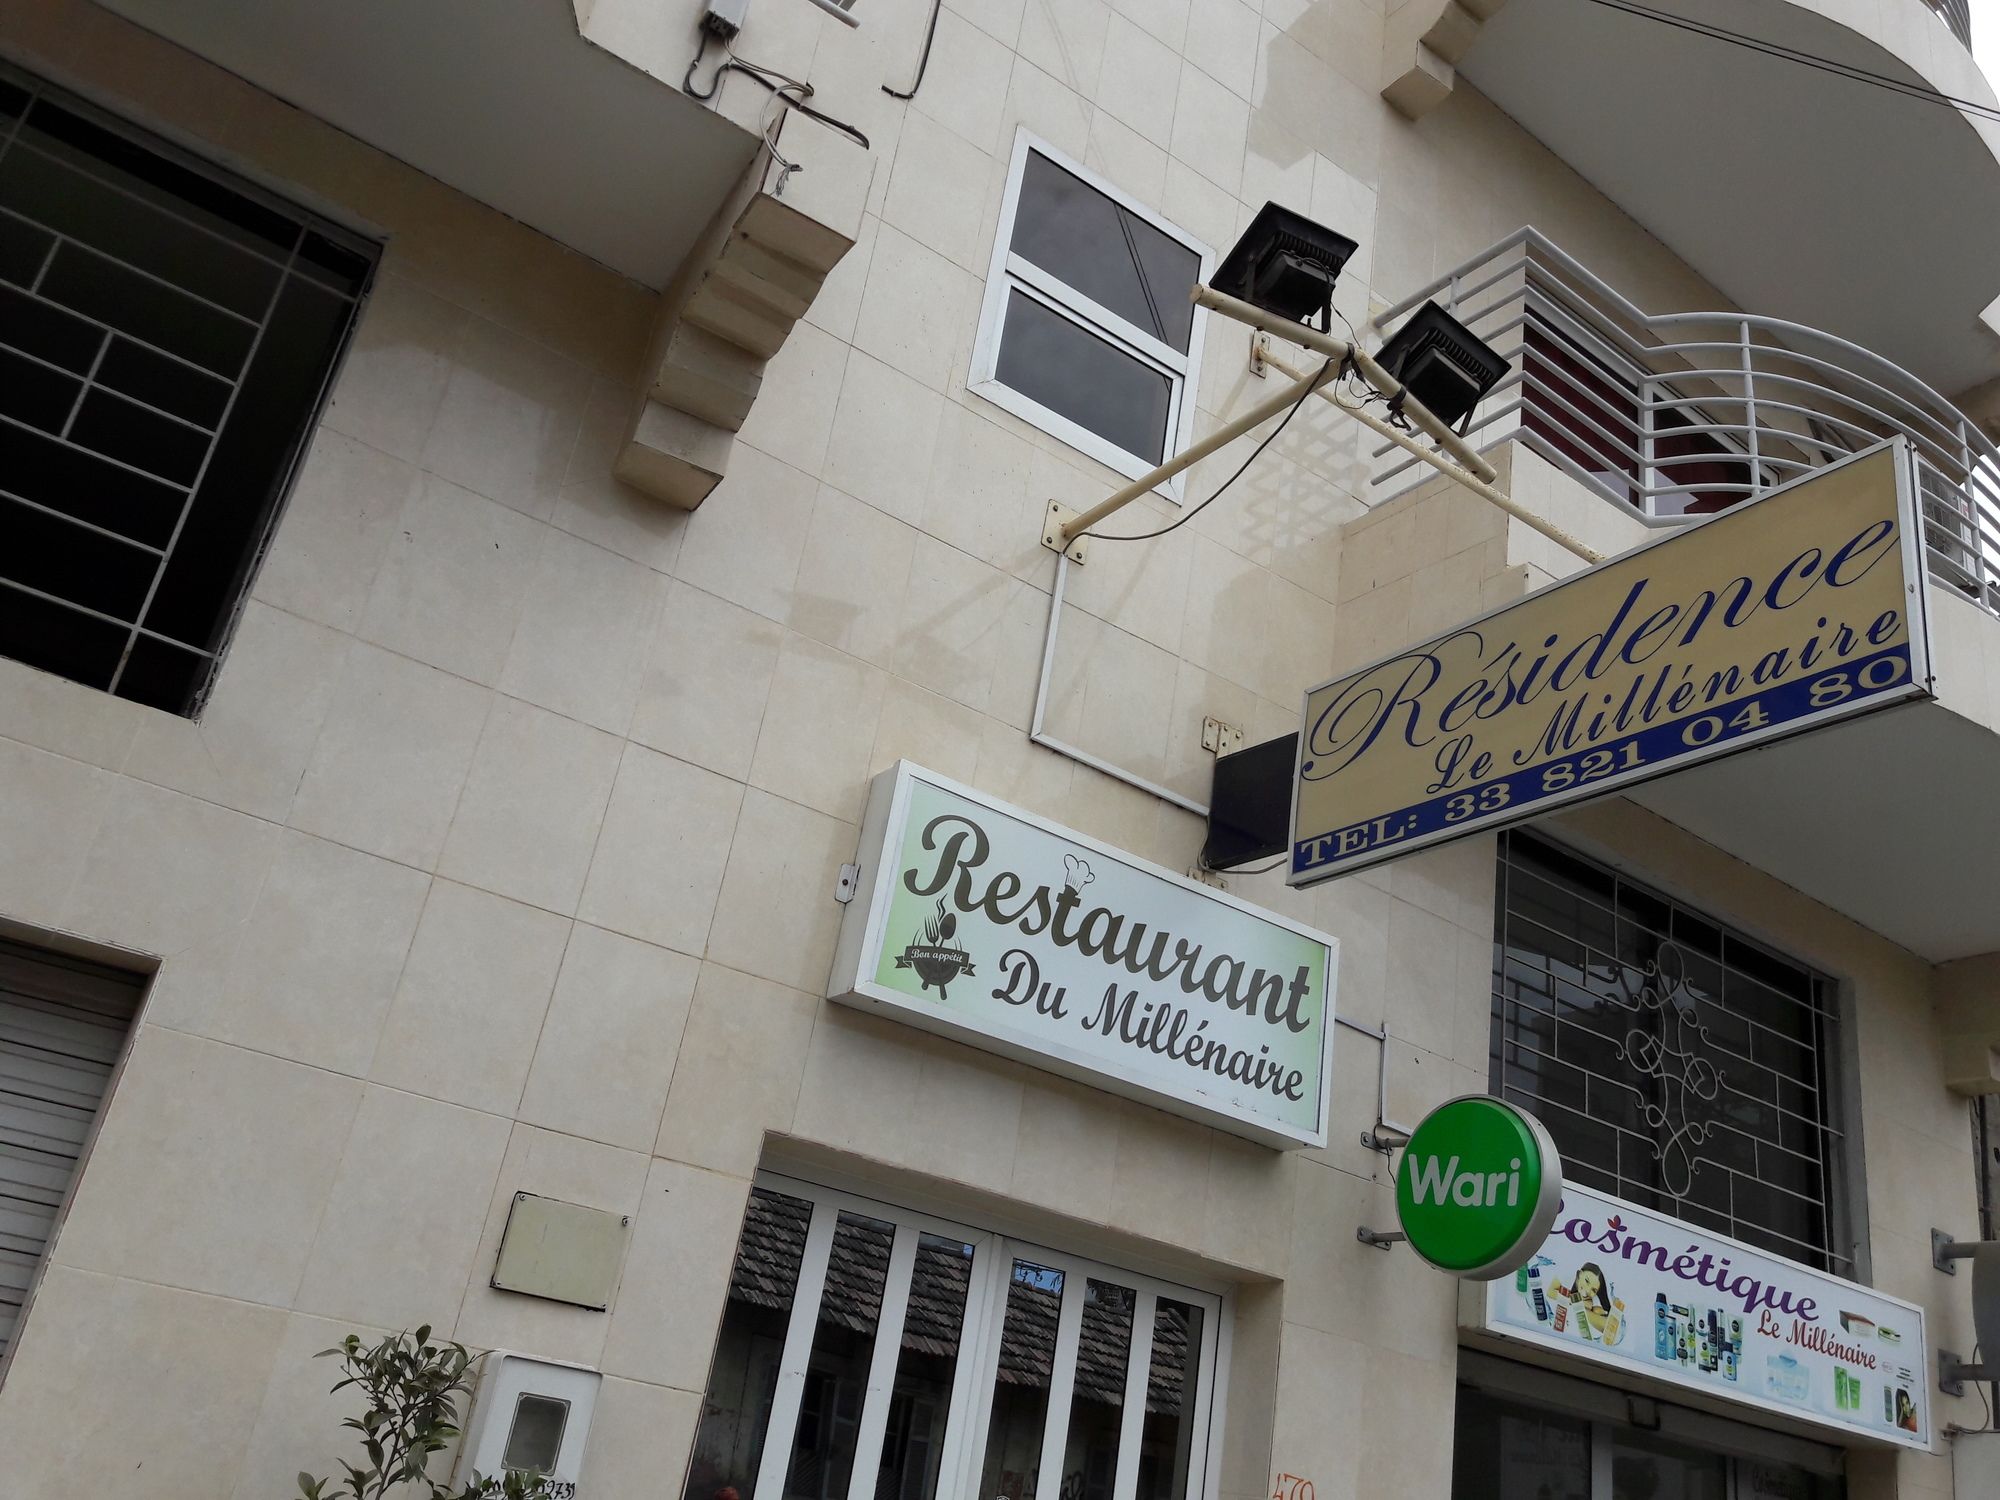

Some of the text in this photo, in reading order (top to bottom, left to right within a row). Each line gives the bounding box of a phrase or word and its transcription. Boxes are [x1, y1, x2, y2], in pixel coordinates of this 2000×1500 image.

[1301, 519, 1901, 782] Résidence
[1426, 610, 1902, 795] Le Millénaire
[1301, 654, 1909, 868] TEL: 33 821 04 80
[903, 814, 1311, 1033] Restaurant
[910, 948, 963, 963] Bon appétit
[991, 948, 1304, 1102] Du Millénaire
[1408, 1152, 1522, 1207] Wari
[1549, 1198, 1820, 1322] osmétique
[1757, 1309, 1877, 1370] Le Millénaire
